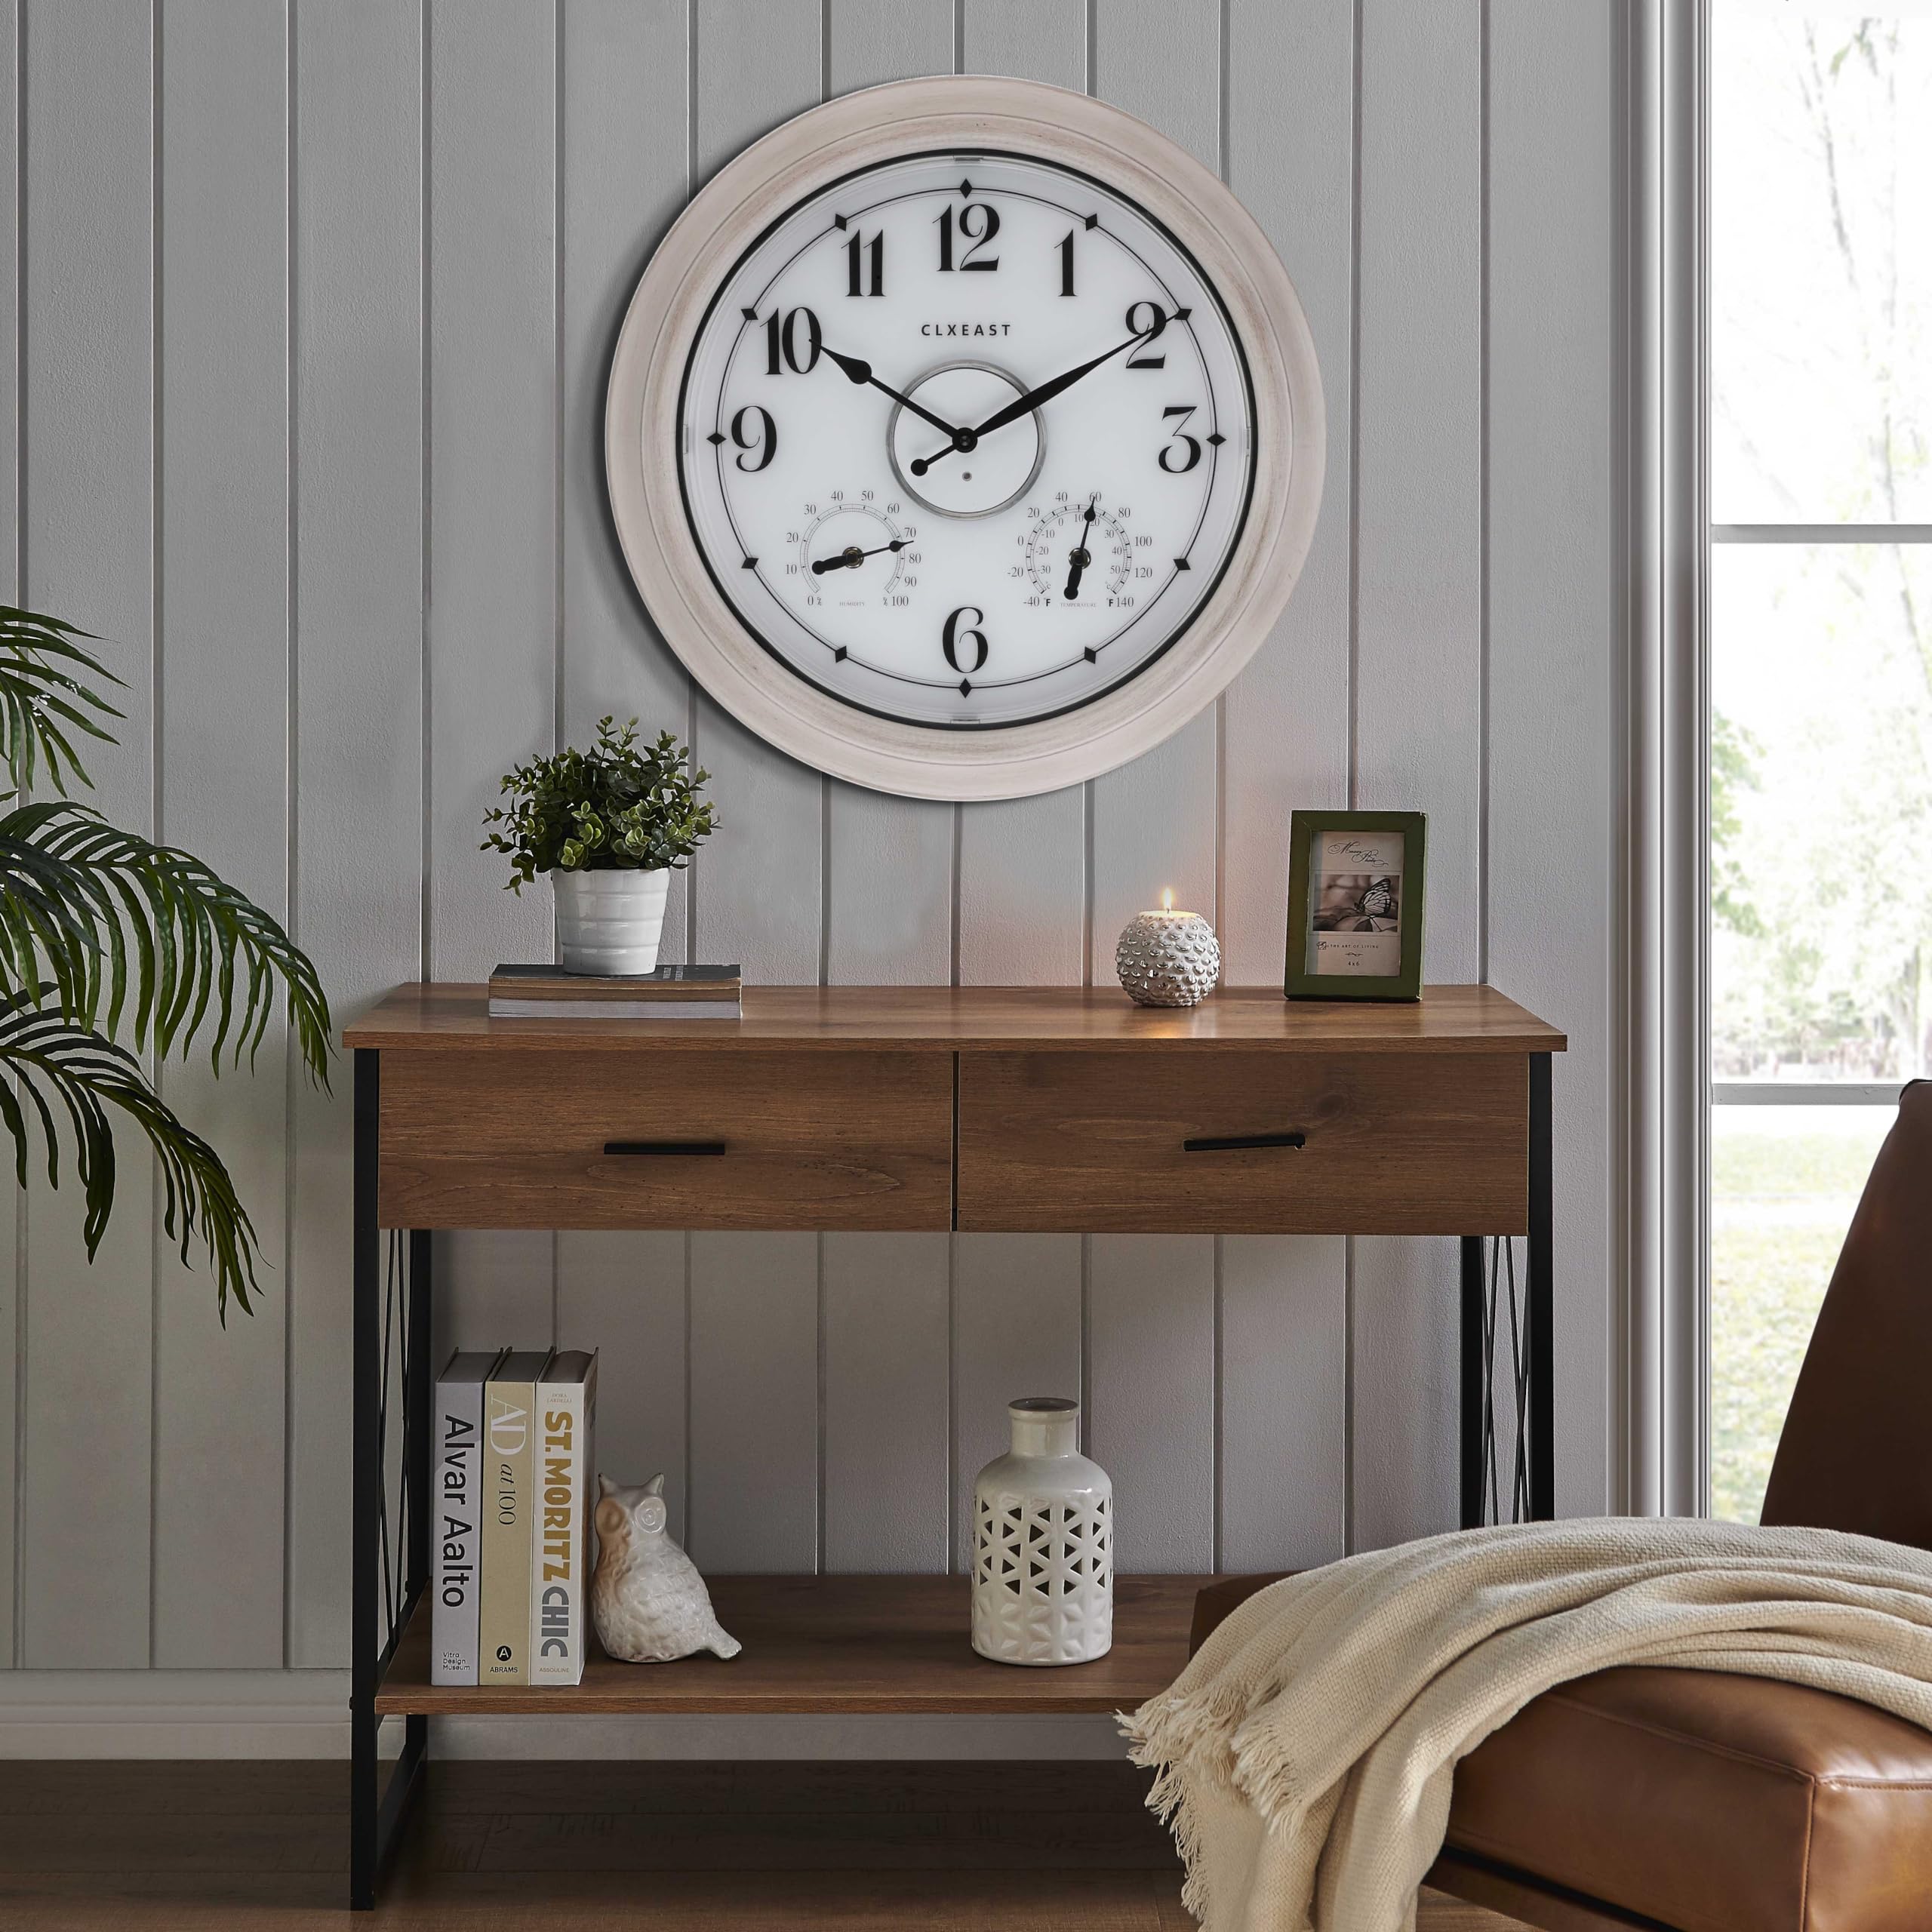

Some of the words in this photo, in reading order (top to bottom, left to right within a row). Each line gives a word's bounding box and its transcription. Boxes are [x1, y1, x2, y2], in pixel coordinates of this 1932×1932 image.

[932, 203, 1000, 272] 12
[841, 229, 885, 297] 11
[1054, 229, 1077, 297] 1
[921, 324, 1011, 337] CLXEAST
[1124, 301, 1168, 369] 2
[760, 306, 822, 375] 10
[731, 405, 777, 472] 9
[1158, 406, 1201, 473] 3
[830, 491, 844, 501] 40
[861, 491, 874, 501] 50
[1055, 491, 1068, 502] 40
[1089, 491, 1102, 503] 60
[804, 504, 817, 515] 30
[887, 503, 900, 514] 60
[1027, 507, 1040, 518] 20
[1118, 507, 1131, 518] 80
[1058, 517, 1064, 527] 0
[1075, 513, 1084, 523] 10
[786, 532, 799, 543] 20
[904, 527, 917, 538] 70
[1041, 529, 1055, 538] -10
[1104, 529, 1115, 539] 30
[1017, 536, 1024, 546] 0
[1135, 536, 1152, 546] 100
[1035, 546, 1049, 555] -20
[1112, 546, 1122, 555] 40
[909, 553, 921, 564] 80
[786, 564, 798, 574] 10
[1008, 567, 1024, 577] -20
[1037, 565, 1051, 574] -30
[1110, 565, 1121, 574] 50
[1135, 567, 1152, 578] 120
[904, 577, 917, 587] 90
[807, 595, 814, 606] 0
[892, 595, 909, 607] 100
[1023, 595, 1040, 607] -40
[1117, 596, 1134, 608] 140
[942, 607, 989, 674] 6
[491, 1394, 528, 1456] AD
[544, 1411, 574, 1453] ST.
[444, 1414, 475, 1506] Alvar
[500, 1463, 515, 1485] at
[498, 1489, 516, 1525] 100
[543, 1458, 572, 1582] MORITZ
[441, 1515, 474, 1607] Aalto
[540, 1586, 570, 1658] CHIC
